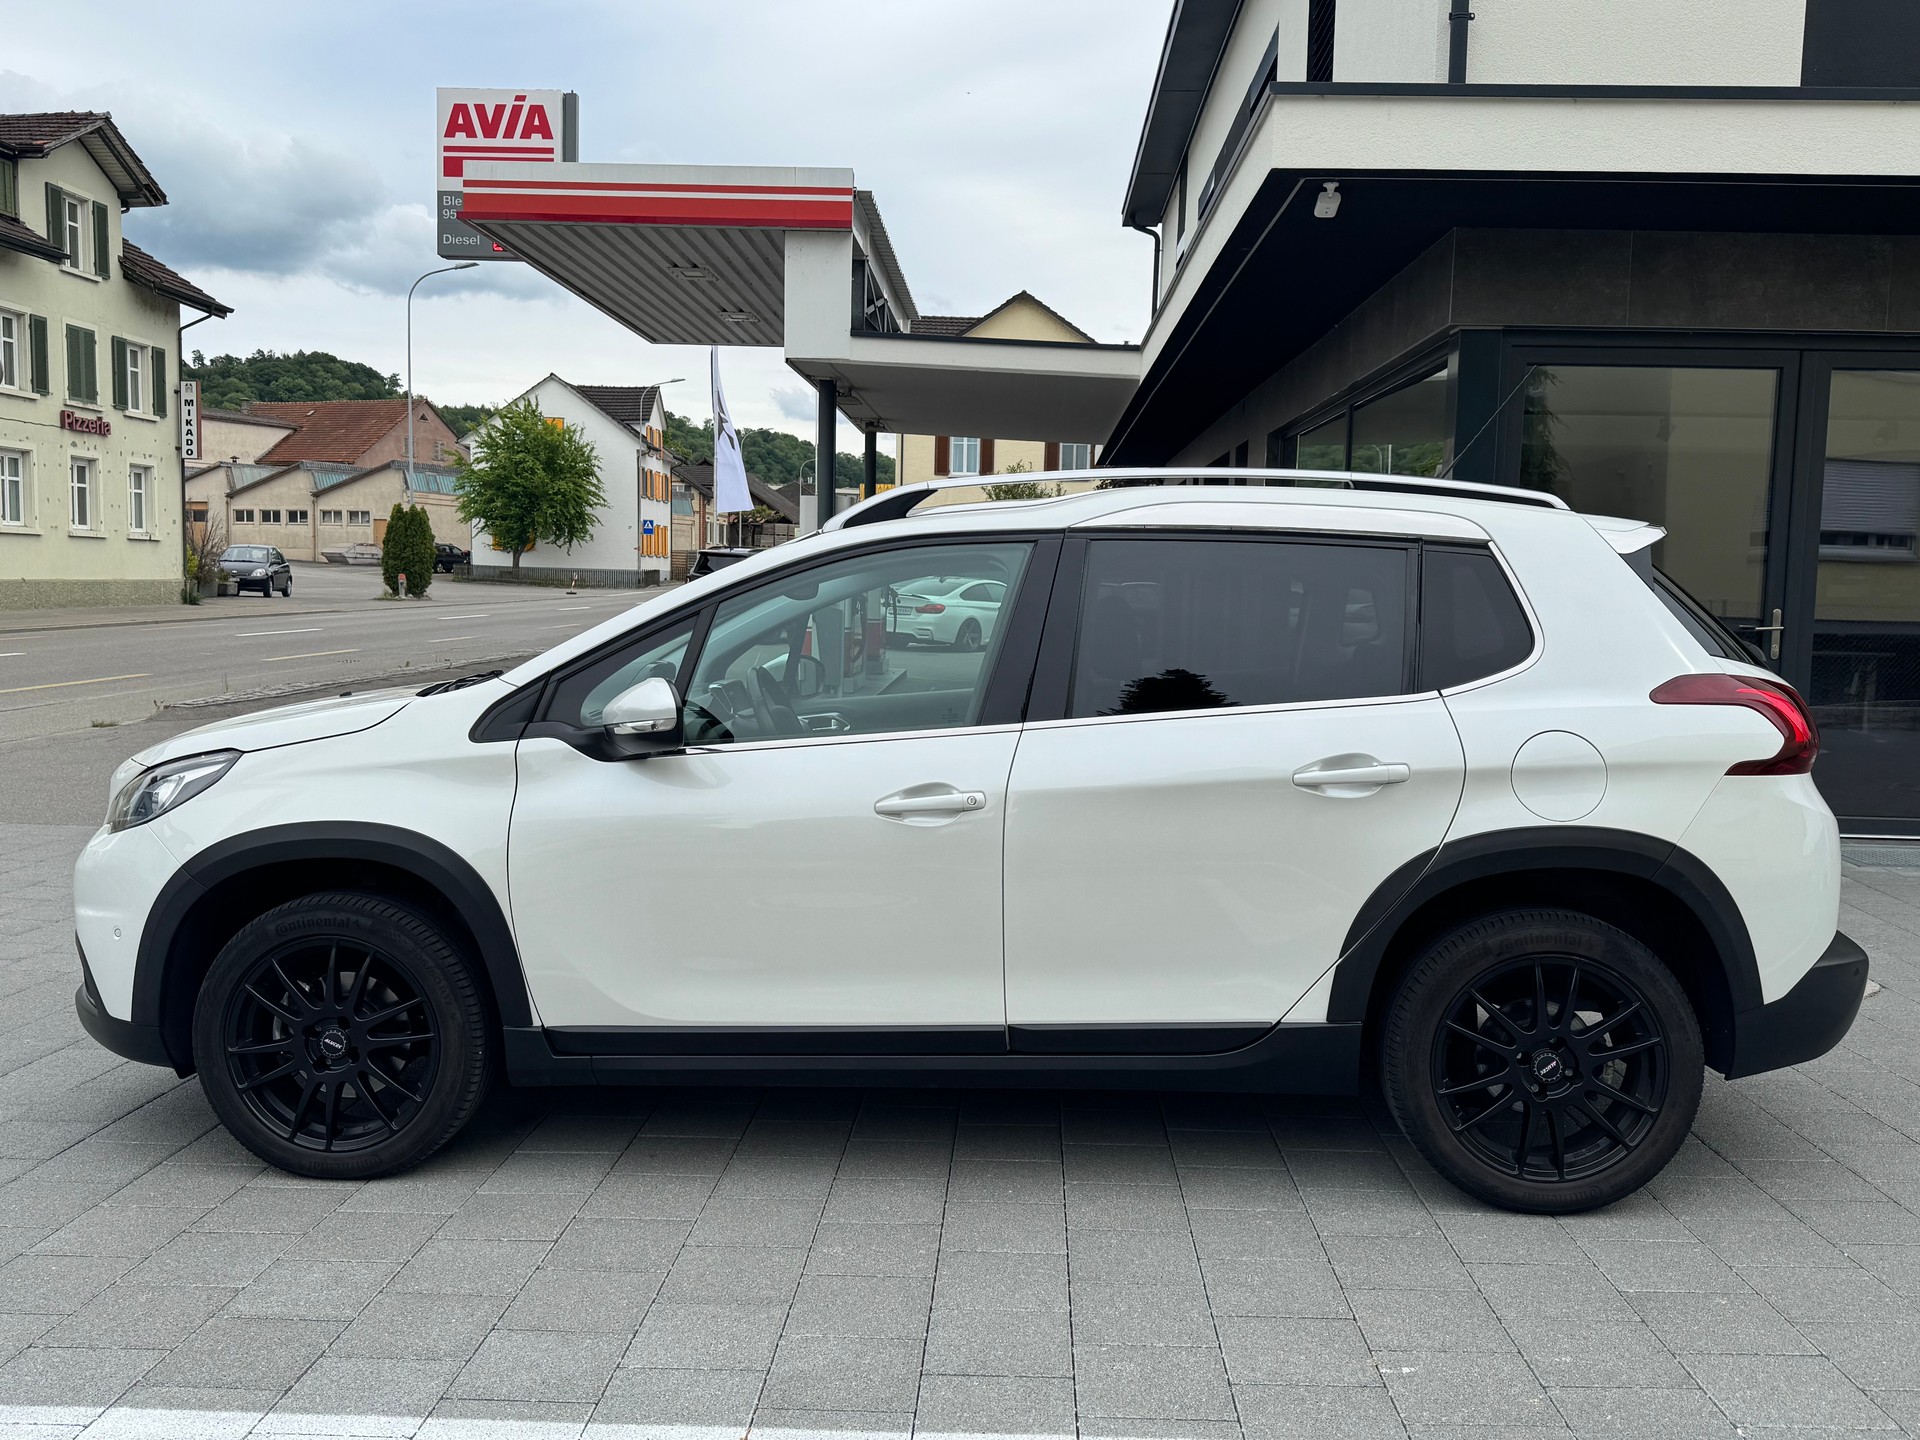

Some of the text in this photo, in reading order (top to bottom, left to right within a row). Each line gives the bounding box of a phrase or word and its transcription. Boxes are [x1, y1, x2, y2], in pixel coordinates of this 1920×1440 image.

[443, 209, 457, 219] 95
[443, 234, 480, 245] Diesel
[63, 410, 111, 436] Pizzeria
[184, 398, 194, 456] MIKADO
[275, 916, 350, 937] Continental
[1500, 932, 1583, 953] Continental
